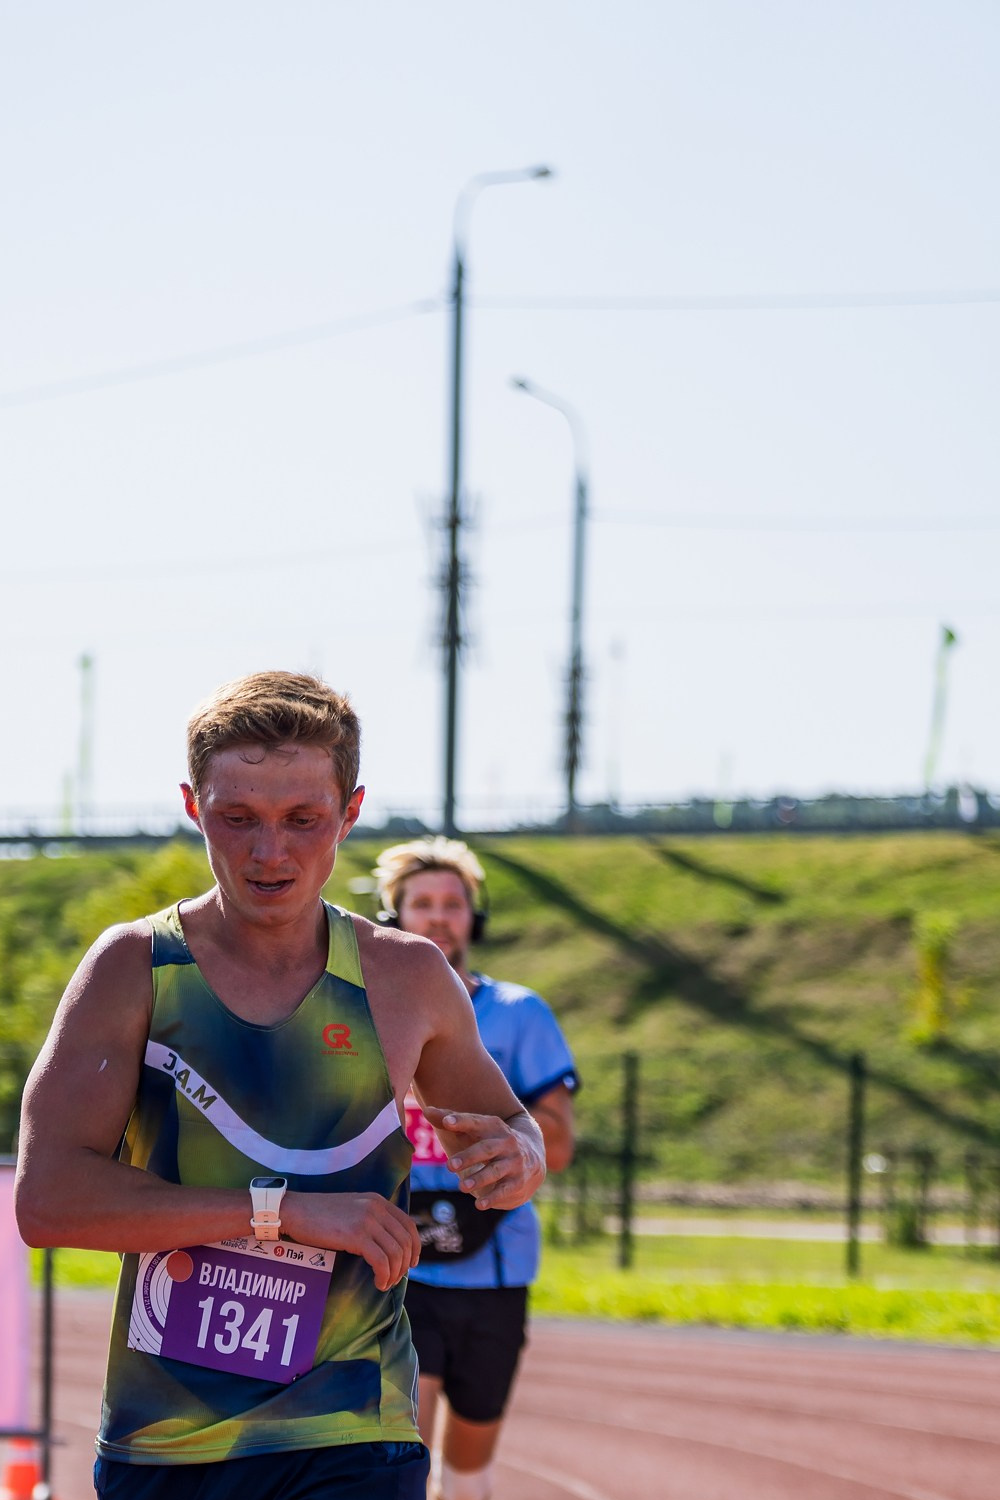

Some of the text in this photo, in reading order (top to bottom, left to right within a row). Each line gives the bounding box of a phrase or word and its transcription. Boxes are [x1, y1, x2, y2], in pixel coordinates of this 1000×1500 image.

[286, 1248, 304, 1261] Пэй
[198, 1261, 307, 1305] ВЛАДИМИР
[197, 1296, 300, 1366] 1341
